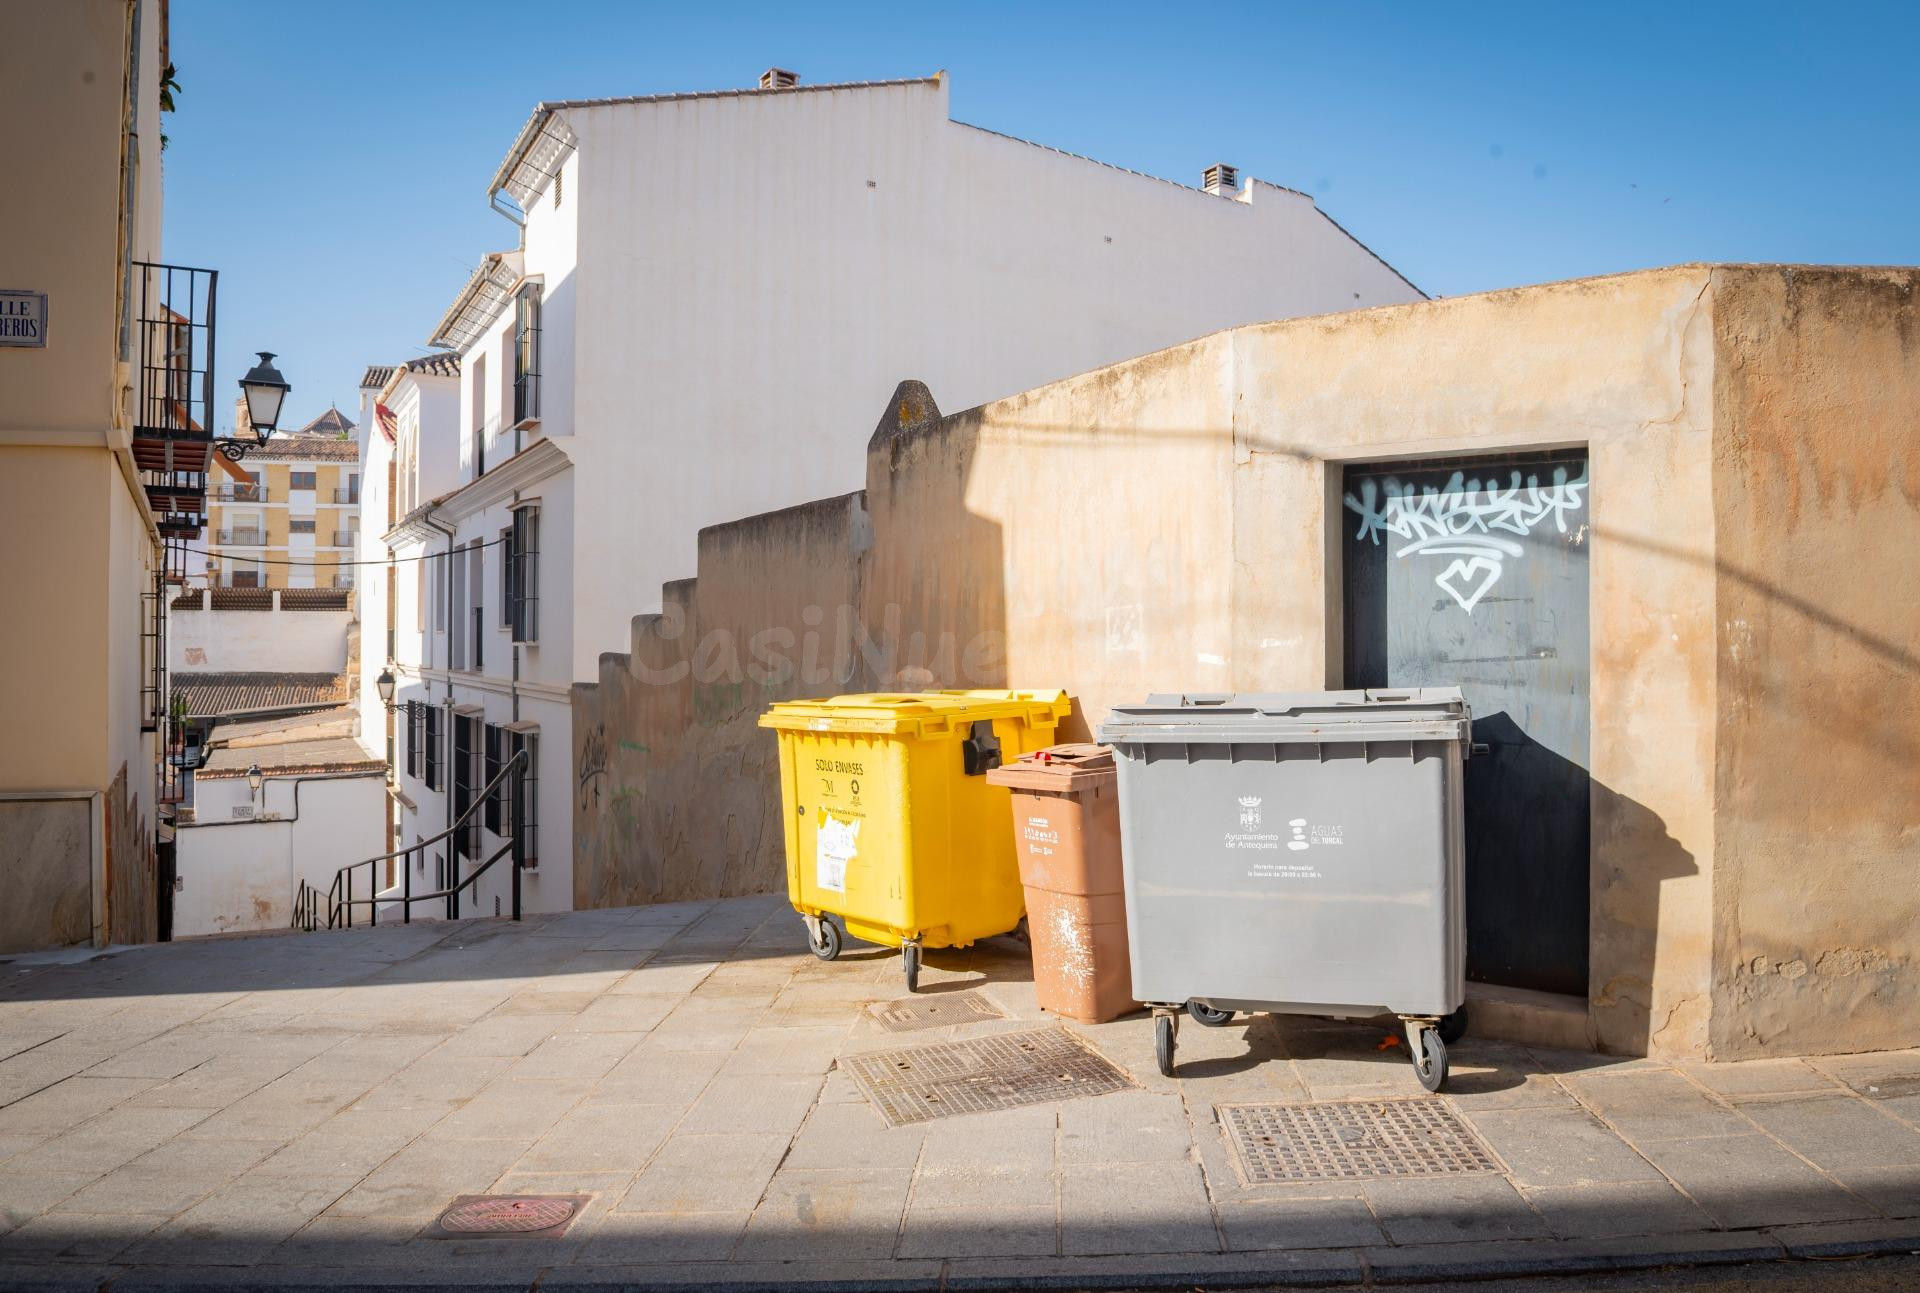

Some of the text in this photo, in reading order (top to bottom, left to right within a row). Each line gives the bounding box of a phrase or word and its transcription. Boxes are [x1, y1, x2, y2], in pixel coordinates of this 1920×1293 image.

[815, 759, 864, 776] SOLO ENVASES
[1311, 825, 1343, 837] AGUAS
[1224, 832, 1279, 842] Ayuntamiento
[1238, 841, 1278, 850] Antequera
